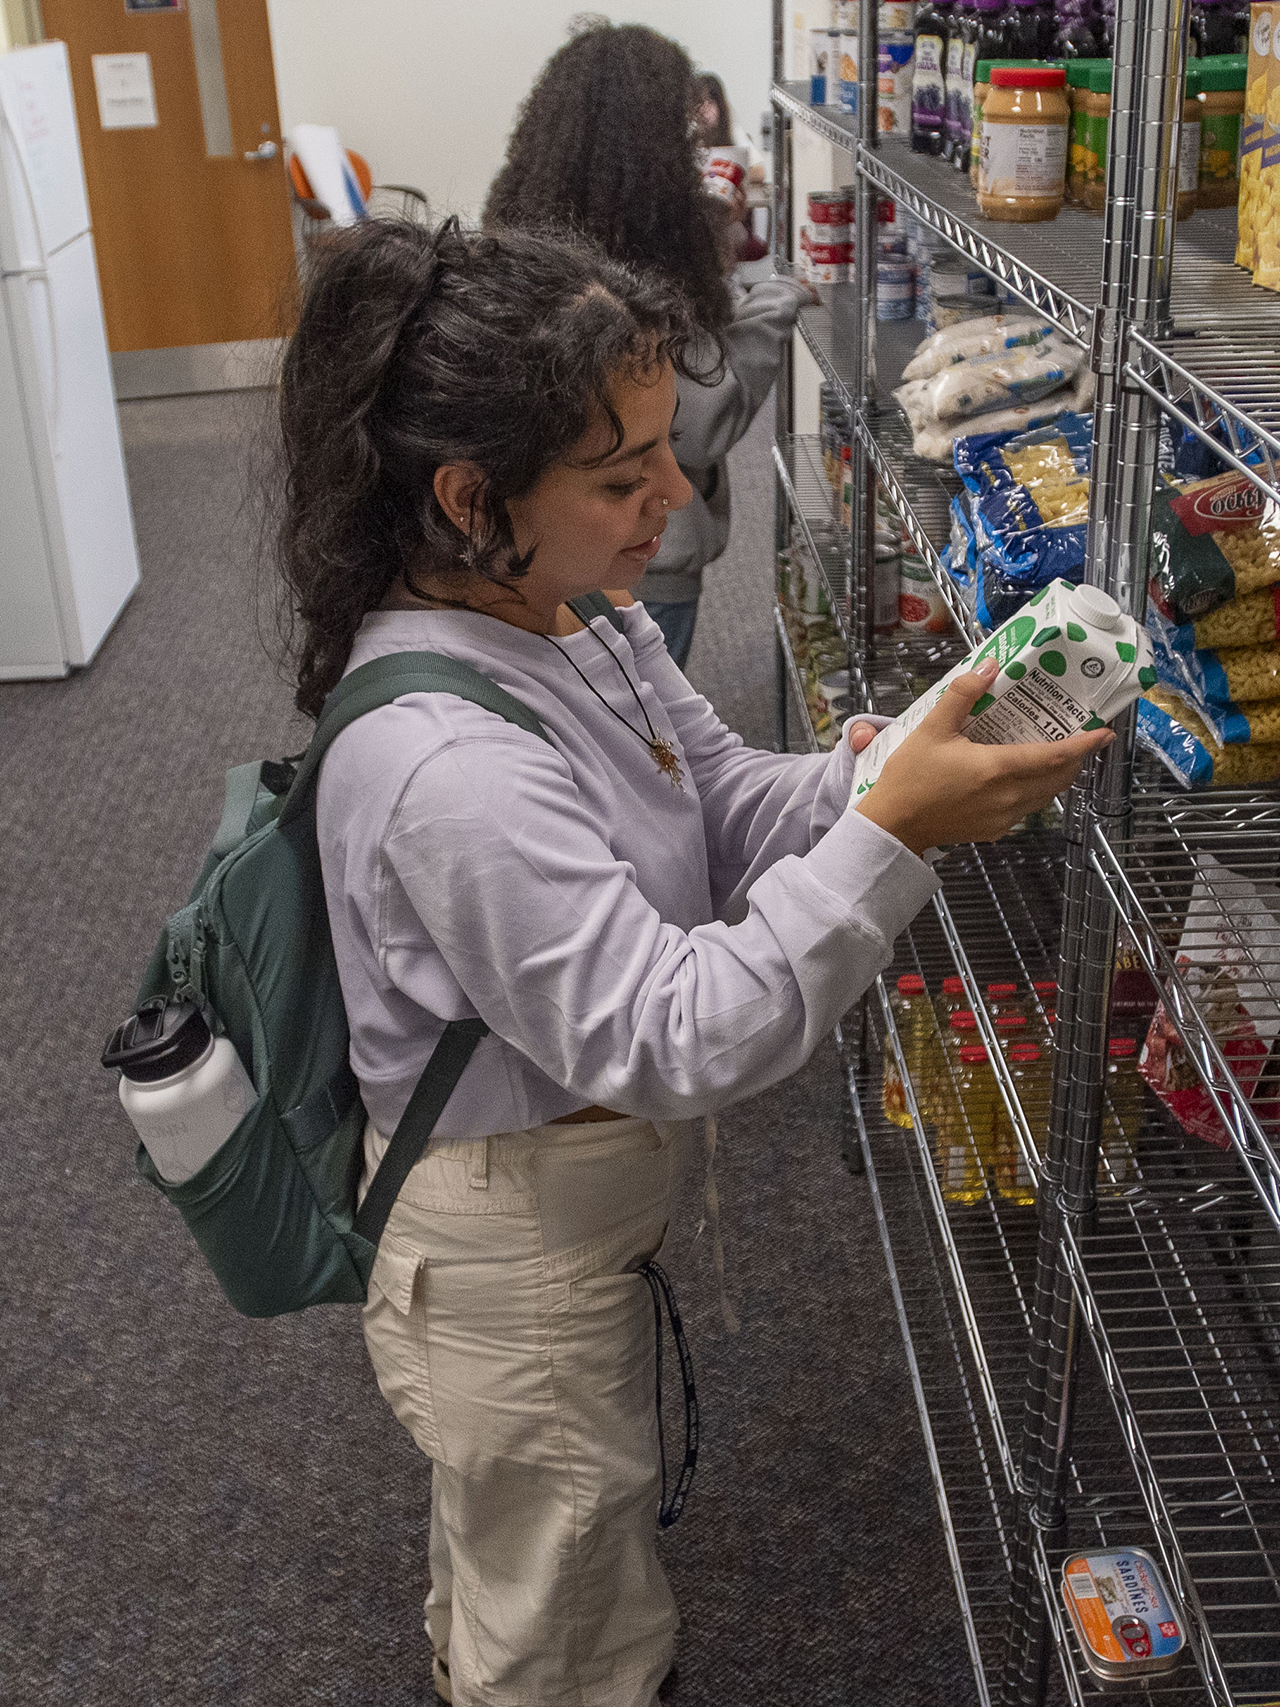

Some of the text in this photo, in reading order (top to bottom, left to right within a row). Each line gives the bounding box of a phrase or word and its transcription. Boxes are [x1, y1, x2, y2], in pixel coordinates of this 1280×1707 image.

[1006, 691, 1066, 742] Calories 110
[1029, 669, 1087, 723] Nutrition Facts
[1116, 1560, 1149, 1614] SARDINES
